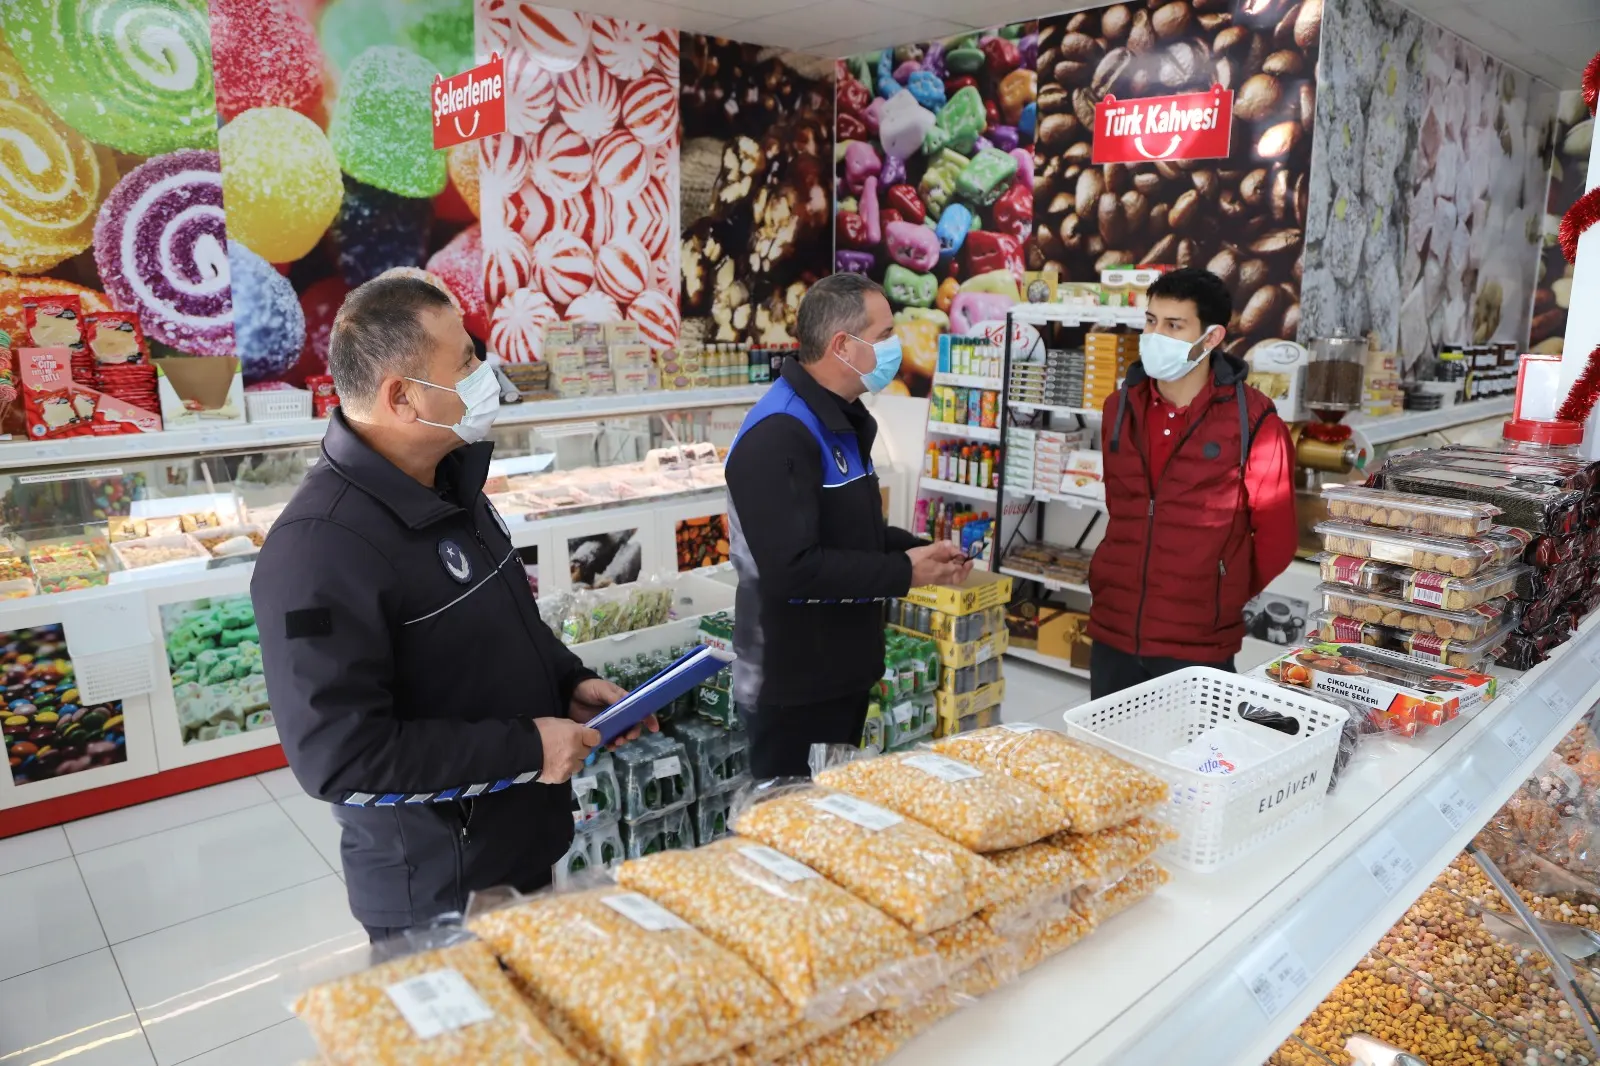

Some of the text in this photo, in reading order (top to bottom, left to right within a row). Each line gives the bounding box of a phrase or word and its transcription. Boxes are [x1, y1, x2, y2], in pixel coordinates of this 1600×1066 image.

[434, 73, 502, 127] Şekerleme
[1105, 98, 1220, 137] Türk Kahvesi
[1317, 682, 1350, 697] KESTANE
[1258, 769, 1318, 814] ELDİVEN
